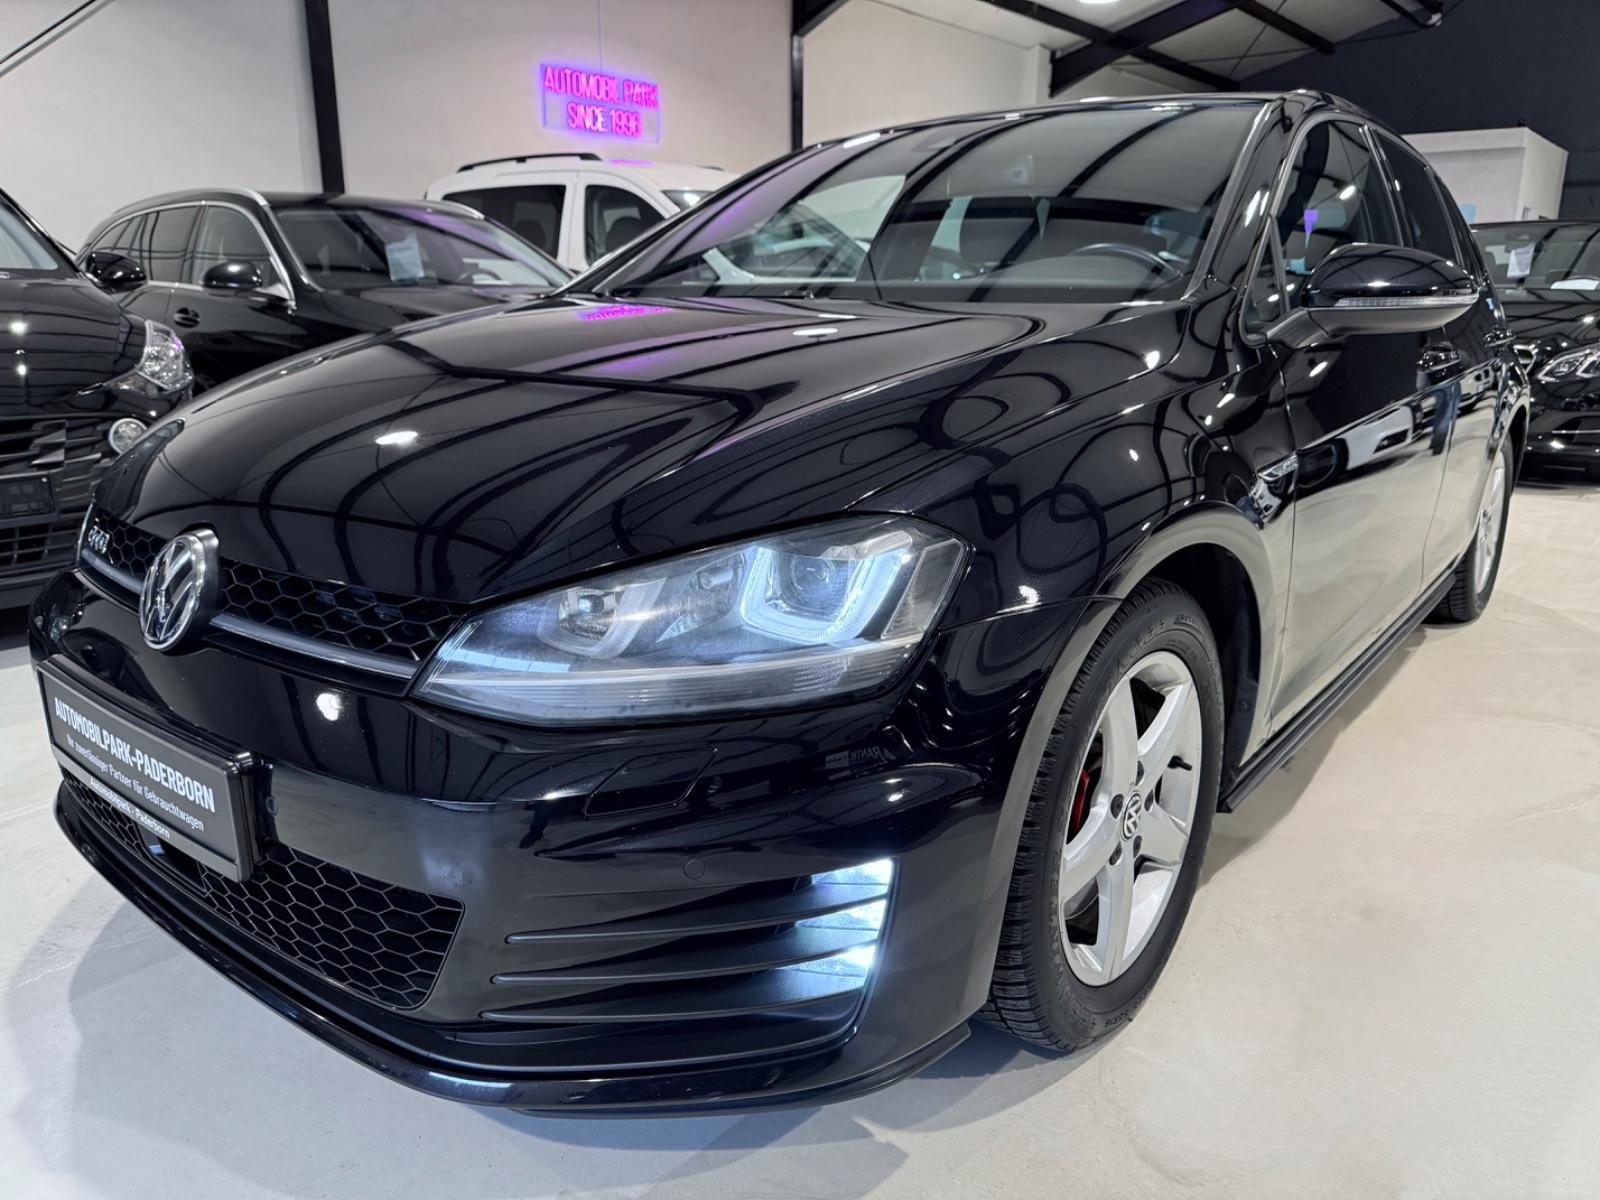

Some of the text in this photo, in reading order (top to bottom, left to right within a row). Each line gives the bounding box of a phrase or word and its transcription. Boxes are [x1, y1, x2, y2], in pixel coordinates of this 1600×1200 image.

[544, 66, 657, 108] AUTOMOBIL PARK
[567, 101, 607, 133] SINCE
[54, 696, 216, 813] AUTOMOBILPARK-PADERBORN
[109, 763, 132, 788] Partner
[132, 779, 143, 796] für
[143, 786, 205, 832] Gebrauchtwagen
